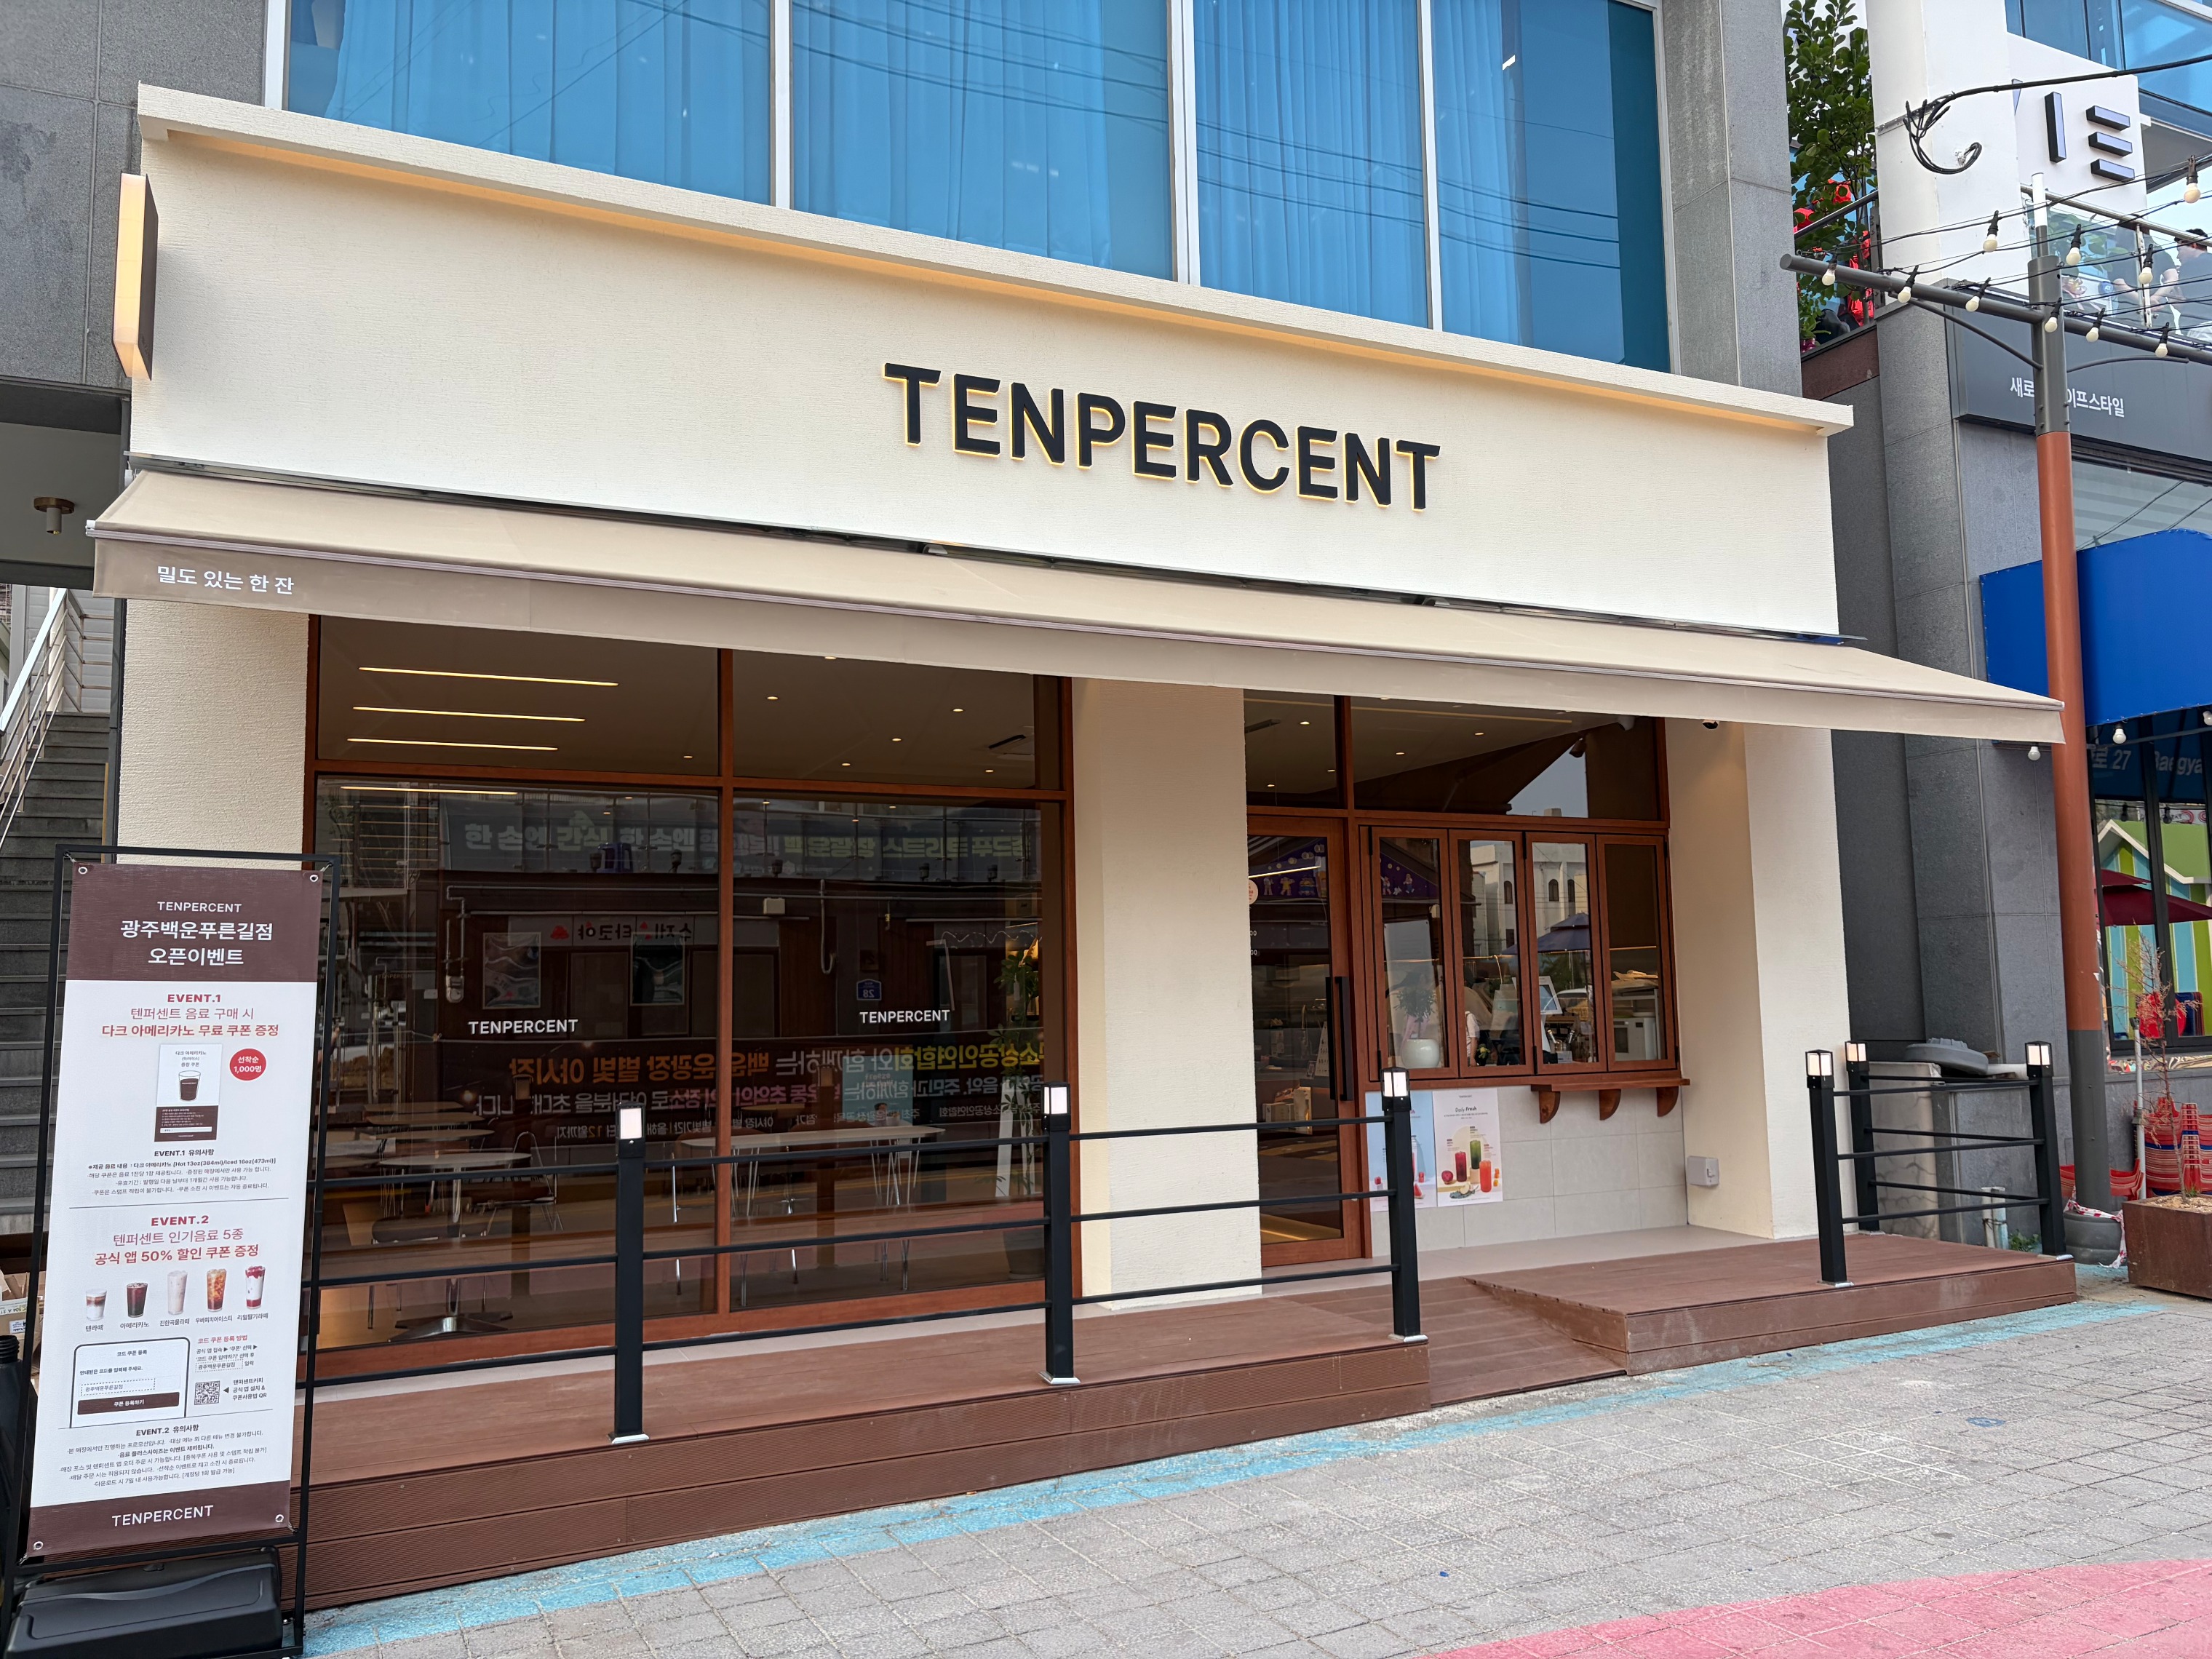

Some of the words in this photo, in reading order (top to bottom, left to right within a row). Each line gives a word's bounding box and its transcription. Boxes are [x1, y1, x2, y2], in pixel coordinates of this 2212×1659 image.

[2067, 388, 2125, 418] 이프스타일
[883, 362, 1441, 512] TENPERCENT
[158, 566, 197, 584] 밀도
[204, 570, 243, 590] 있는
[250, 574, 269, 592] 한
[274, 577, 295, 595] 잔
[157, 902, 242, 913] TENPERCENT
[120, 920, 273, 941] 광주백운푸른길점
[148, 948, 244, 966] 오픈이벤트
[167, 994, 222, 1003] EVENT.1
[131, 1008, 182, 1019] 텐퍼센트
[185, 1008, 210, 1019] 음료
[214, 1008, 238, 1019] 구매
[242, 1008, 253, 1019] 시
[859, 1009, 950, 1024] TENPERCENT
[102, 1025, 128, 1037] 다크
[131, 1025, 195, 1037] 아메리카노
[198, 1025, 223, 1036] 무료
[226, 1025, 252, 1036] 쿠폰
[255, 1025, 279, 1036] 증정
[468, 1019, 578, 1035] TENPERCENT
[237, 1056, 260, 1064] 선착순
[233, 1066, 263, 1074] 1,000명
[151, 1215, 210, 1227] EVENT.2
[114, 1233, 165, 1246] 텐퍼센트
[168, 1230, 219, 1244] 인기음료
[223, 1228, 243, 1240] 5종
[95, 1252, 120, 1265] 공식
[124, 1251, 137, 1264] 앱
[141, 1250, 172, 1262] 50%
[177, 1248, 202, 1261] 할인
[205, 1246, 231, 1259] 쿠폰
[234, 1244, 258, 1257] 증정
[136, 1428, 170, 1436] EVENT.2
[172, 1425, 199, 1433] 유의사항
[111, 1505, 214, 1527] TENPERCENT
